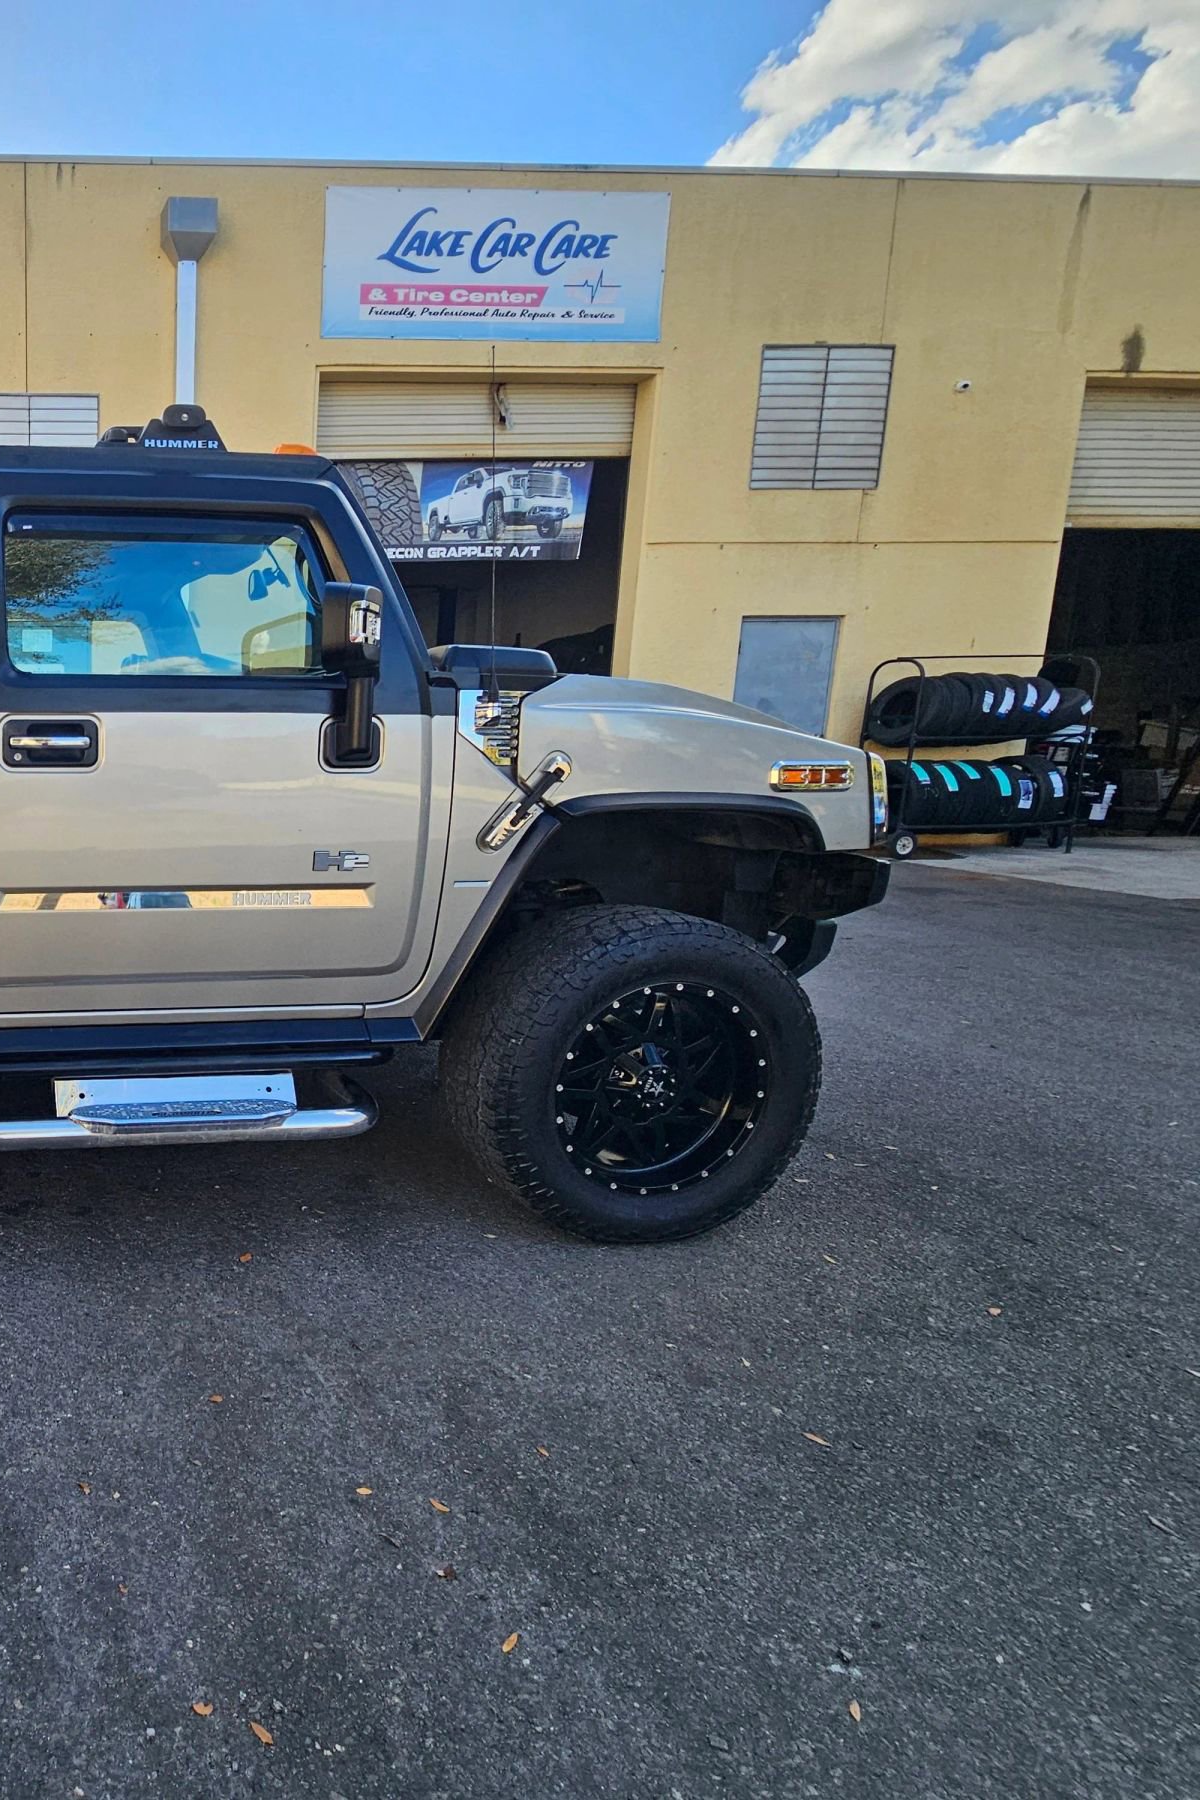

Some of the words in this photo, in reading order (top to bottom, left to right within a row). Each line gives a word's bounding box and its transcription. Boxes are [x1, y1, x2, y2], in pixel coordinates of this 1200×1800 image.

[377, 207, 473, 274] LAKE
[470, 217, 537, 274] CAR
[534, 219, 619, 276] CARE
[368, 288, 387, 301] &
[393, 288, 445, 302] Tire
[450, 288, 538, 303] Center
[420, 307, 490, 317] Professional
[491, 308, 517, 318] Auto
[520, 309, 556, 321] Repair
[561, 310, 575, 318] &
[578, 309, 616, 319] Service
[144, 438, 219, 449] HUMMER
[427, 546, 502, 559] GRAPPLER
[509, 545, 541, 558] A/T
[312, 850, 370, 872] H2
[232, 892, 312, 906] HUMMER
